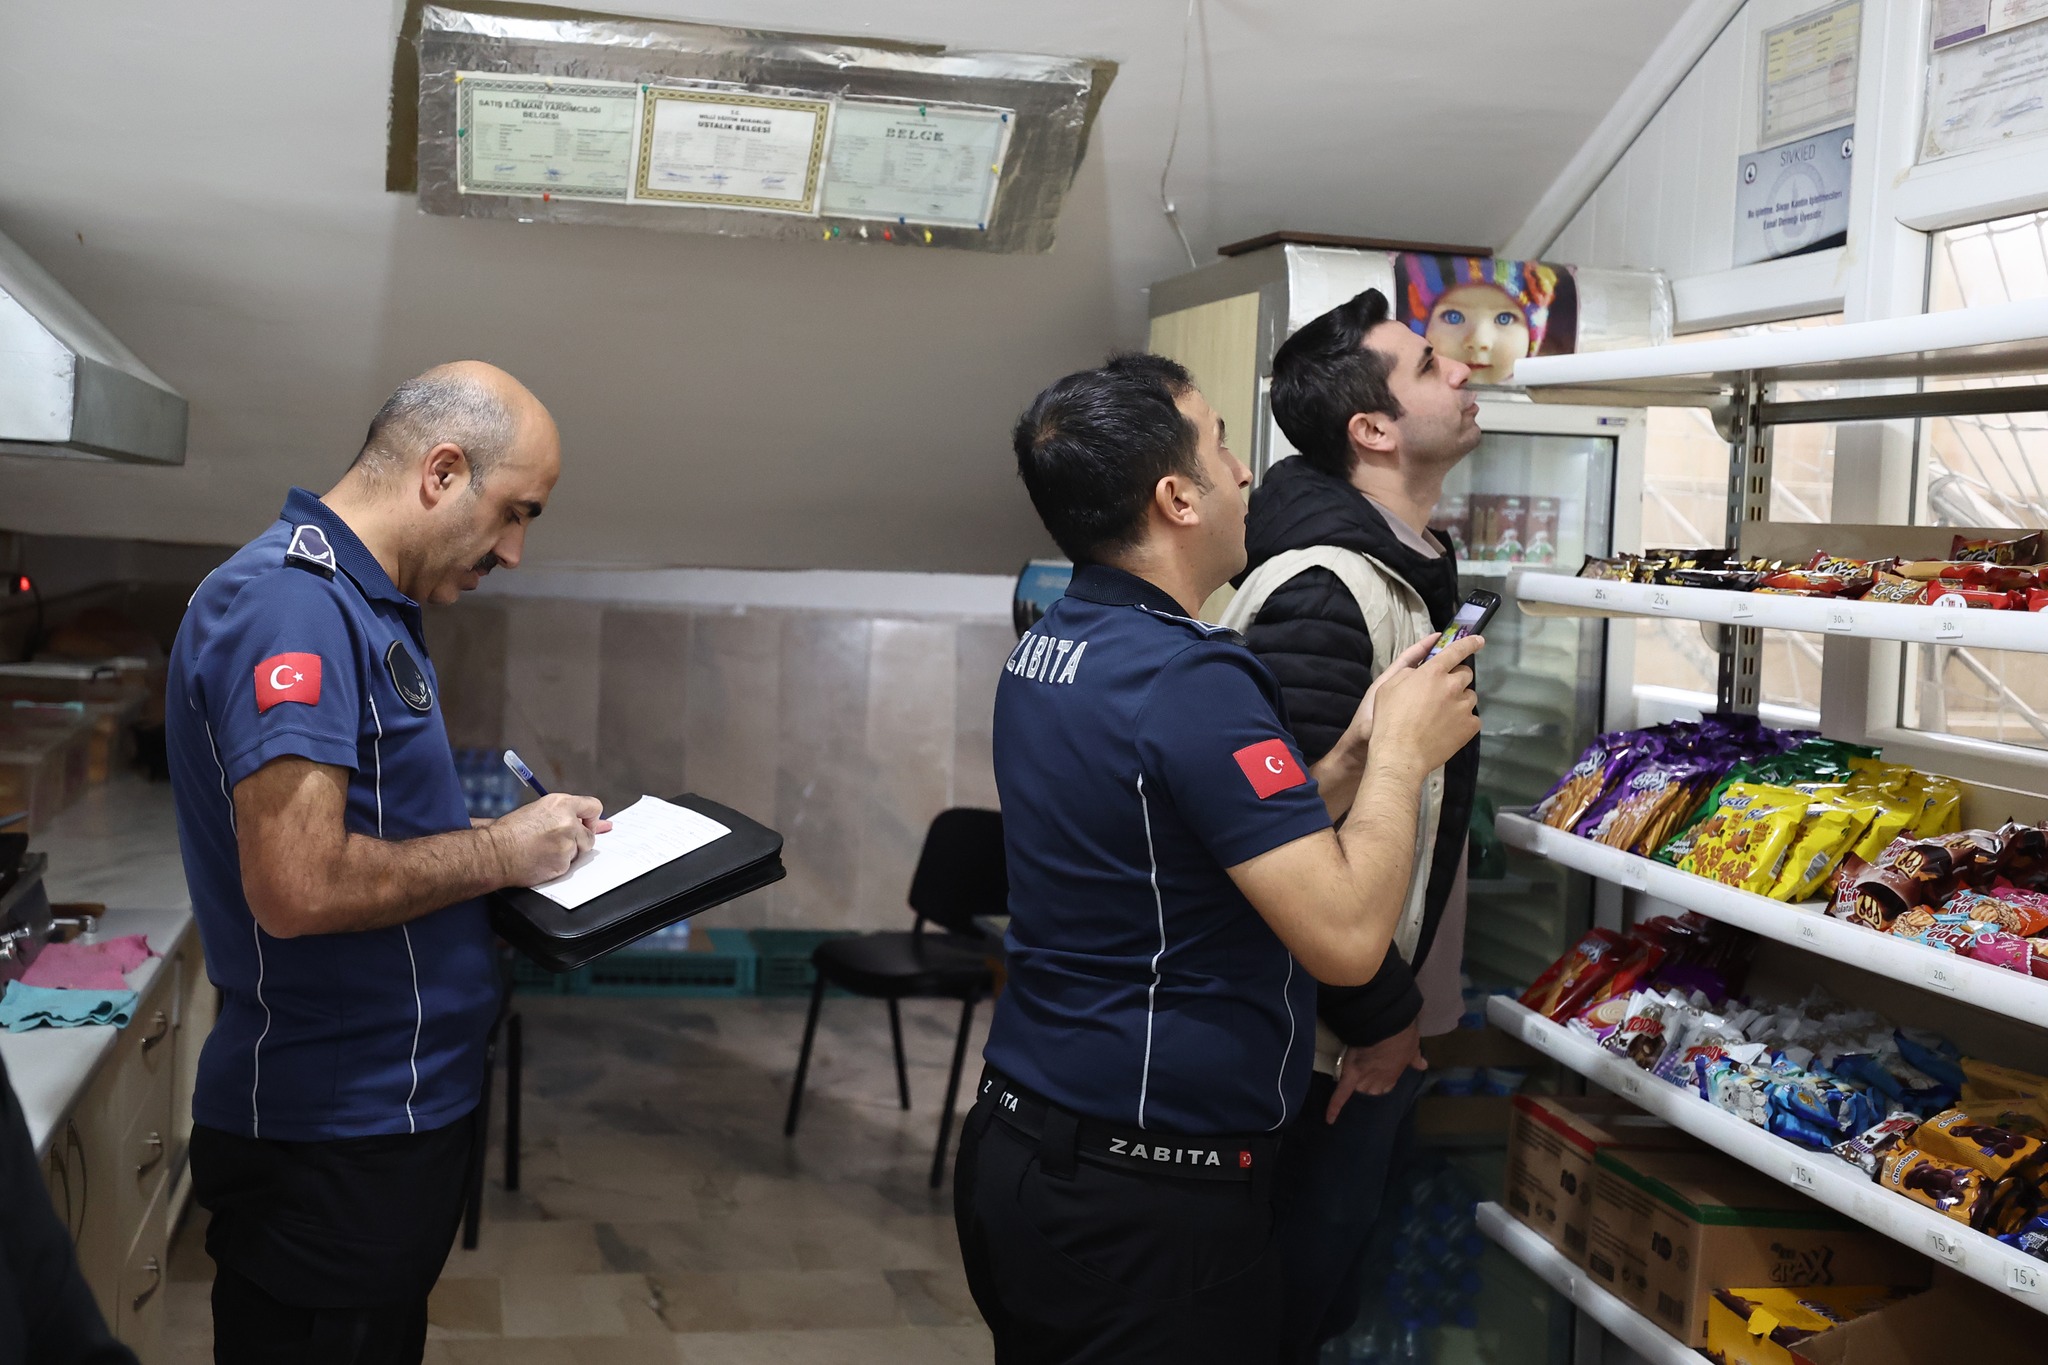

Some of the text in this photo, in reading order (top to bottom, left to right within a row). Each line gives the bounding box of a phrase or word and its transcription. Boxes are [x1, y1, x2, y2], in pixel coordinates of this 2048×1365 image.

[698, 121, 733, 130] USTALIK
[885, 127, 944, 142] BELGE
[1006, 631, 1088, 684] ZABITA
[1623, 1015, 1666, 1038] TODAY
[1109, 1137, 1221, 1167] ZABITA
[1893, 1149, 1920, 1185] Chocobear
